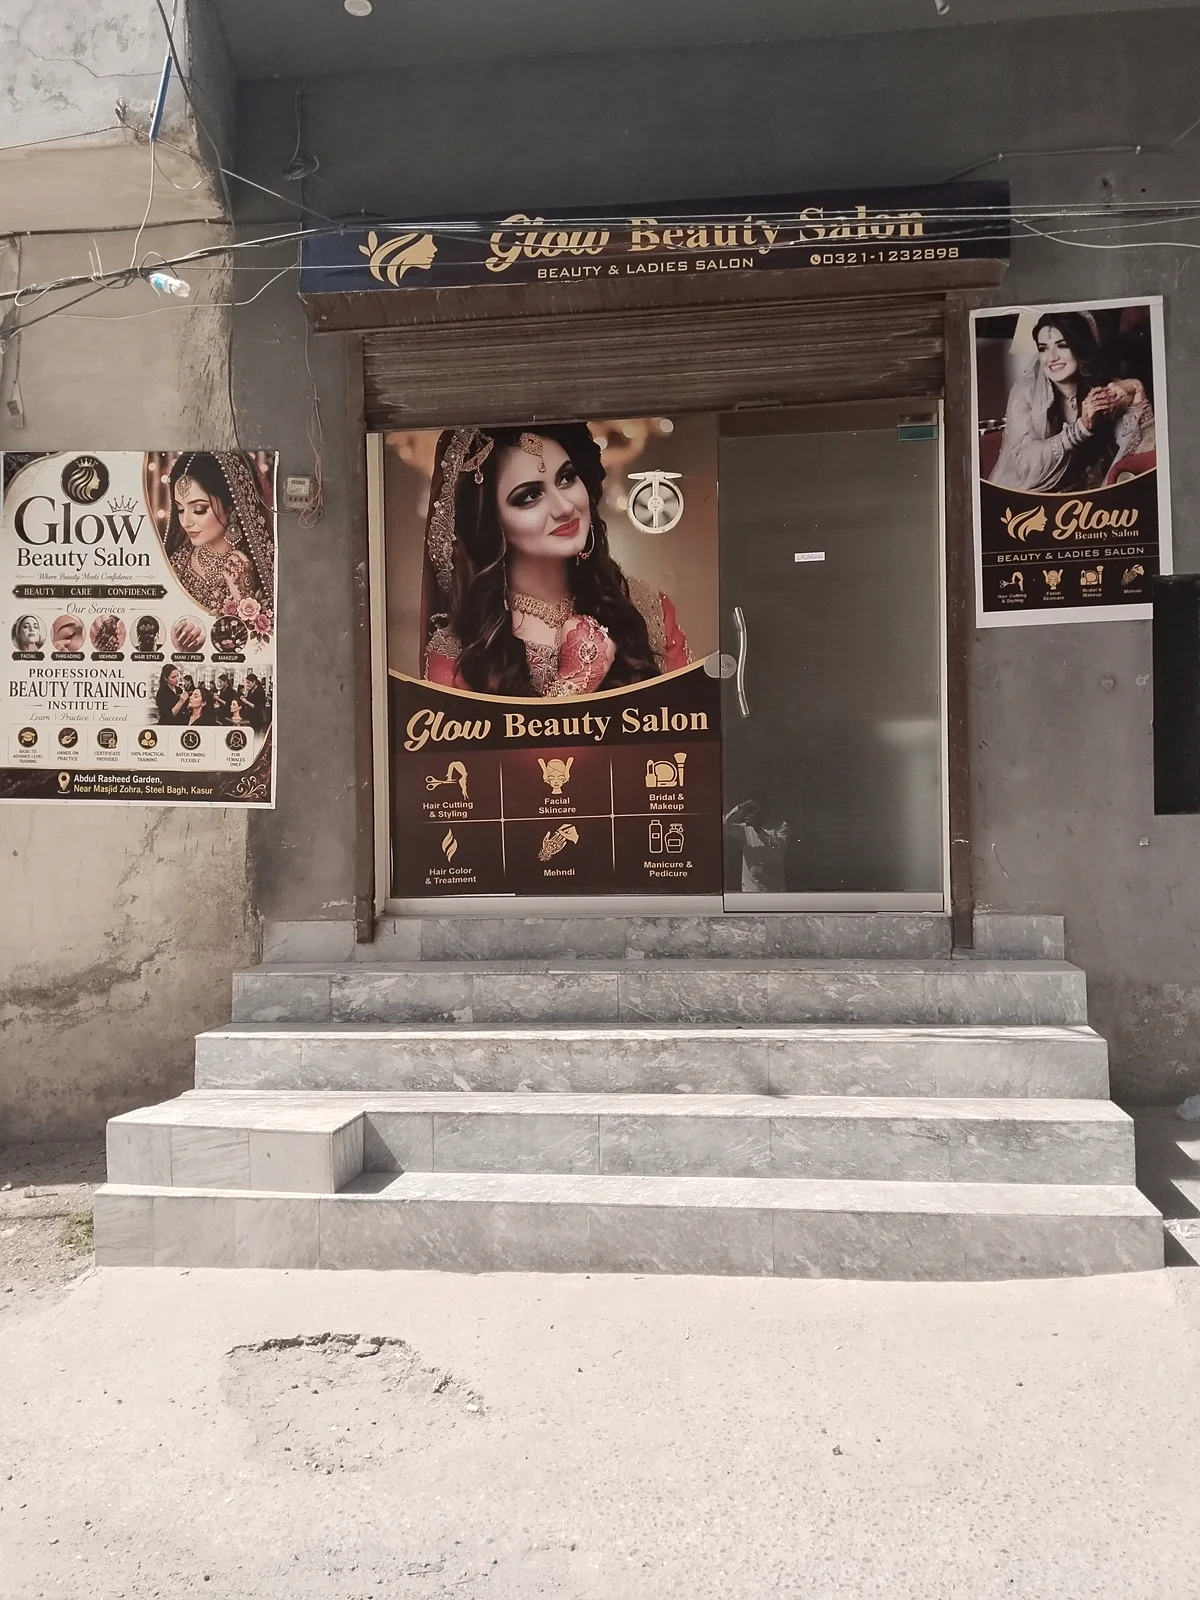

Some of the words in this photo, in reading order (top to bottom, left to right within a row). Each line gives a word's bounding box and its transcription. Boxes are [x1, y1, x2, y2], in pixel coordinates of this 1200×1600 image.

[485, 213, 610, 272] Glow
[627, 215, 781, 254] Beauty
[799, 205, 925, 242] Salon
[823, 247, 959, 264] 0321-1232898
[538, 266, 602, 278] BEAUTY
[608, 265, 619, 274] &
[626, 260, 688, 274] LADIES
[695, 258, 754, 271] SALON
[14, 495, 146, 546] Glow
[1052, 500, 1138, 540] Glow
[1074, 531, 1108, 541] Beauty
[1111, 529, 1139, 538] Salon
[17, 548, 88, 572] Beauty
[94, 546, 150, 568] Salon
[997, 553, 1041, 562] BEAUTY
[1058, 550, 1100, 560] LADIES
[1104, 547, 1145, 556] SALON
[38, 572, 57, 580] Where
[58, 573, 80, 582] Beauty
[101, 573, 133, 582] Confidence
[24, 588, 56, 596] BEAUTY
[70, 588, 92, 596] CARE
[108, 588, 157, 596] CONFIDENCE
[66, 602, 86, 614] Our
[88, 602, 126, 614] Services
[28, 668, 124, 679] PROFESSIONAL
[9, 682, 69, 698] BEAUTY
[74, 682, 147, 698] TRAINING
[48, 700, 109, 711] INSTITUTE
[29, 712, 50, 722] Learn
[60, 712, 88, 722] Practice
[98, 712, 128, 722] Succeed
[403, 708, 492, 752] Glow
[503, 711, 612, 741] Beauty
[621, 706, 709, 734] Salon
[74, 774, 96, 784] Abdul
[98, 774, 130, 784] Rasheed
[132, 775, 163, 785] Garden,
[74, 785, 92, 793] Near
[94, 785, 118, 796] Masjid
[119, 785, 144, 795] Zohra,
[145, 785, 165, 794] Steel
[166, 786, 189, 796] Bagh,
[190, 786, 213, 795] Kasur
[544, 797, 570, 805] Facial
[649, 793, 675, 802] Bridal
[423, 802, 440, 810] Hair
[442, 800, 474, 811] Cutting
[539, 805, 576, 814] Skincare
[650, 802, 684, 812] Makeup
[437, 809, 468, 820] Styling
[644, 861, 684, 869] Manicure
[429, 868, 448, 876] Hair
[450, 867, 472, 875] Color
[543, 868, 575, 877] Mehndi
[649, 870, 688, 878] Pedicure
[433, 876, 476, 885] Treatment
